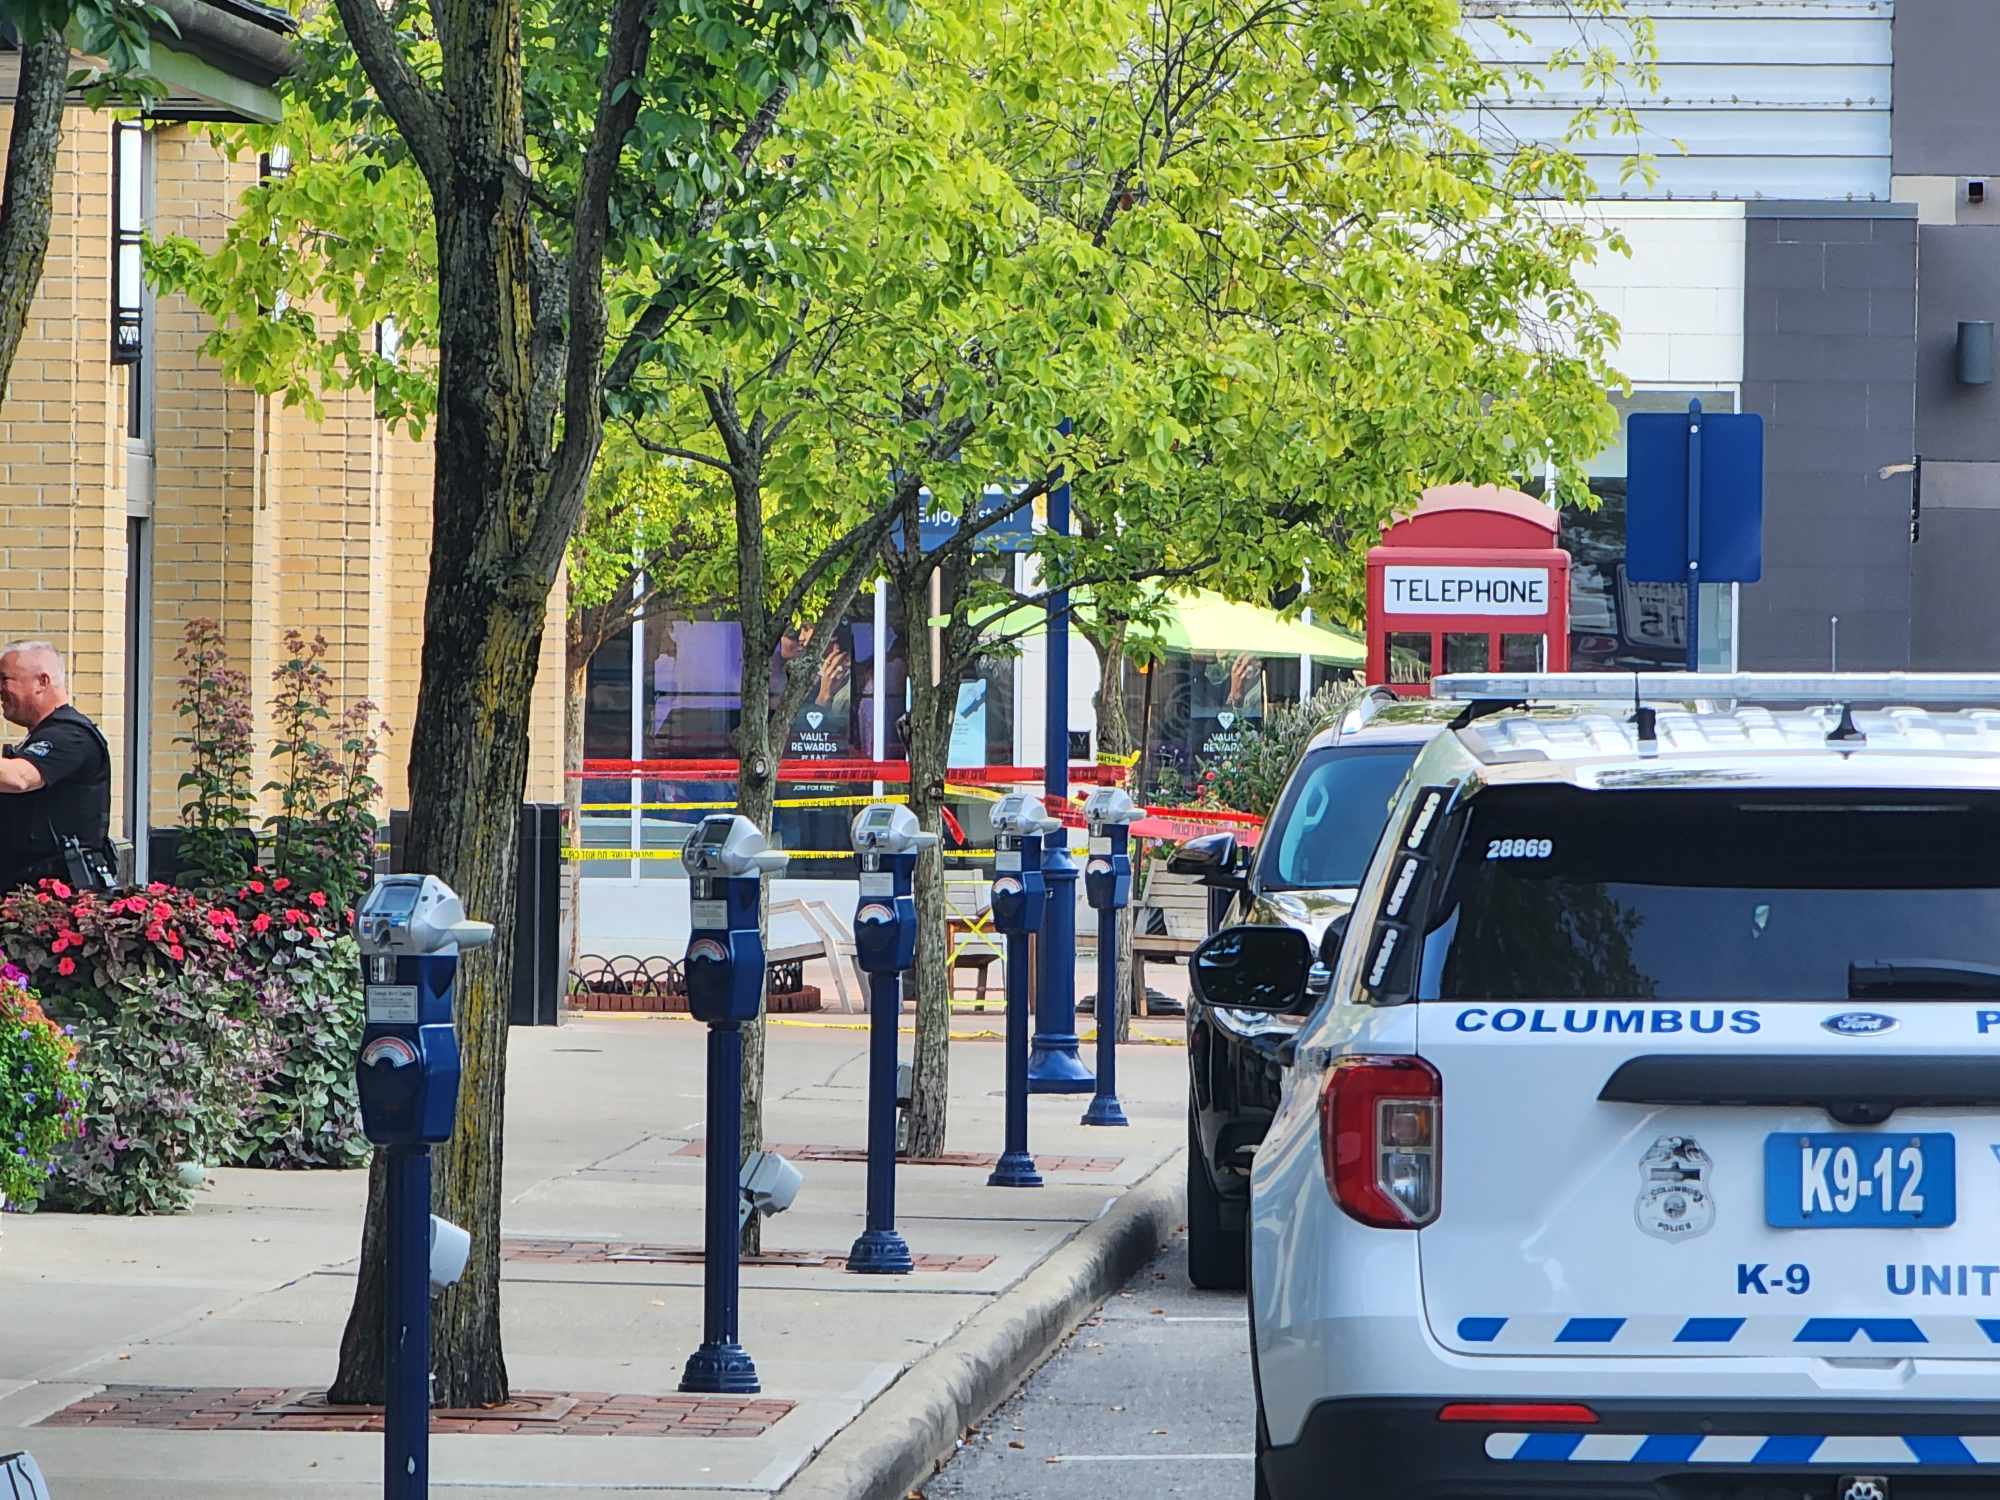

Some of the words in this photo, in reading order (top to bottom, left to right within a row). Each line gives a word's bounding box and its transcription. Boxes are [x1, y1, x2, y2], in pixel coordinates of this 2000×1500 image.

[918, 506, 959, 527] Enjoy
[1390, 579, 1543, 603] TELEPHONE
[791, 742, 837, 752] REWARDS
[800, 732, 829, 741] VAULT
[1486, 838, 1553, 858] 28869
[1455, 1008, 1761, 1034] COLUMBUS
[1837, 1014, 1884, 1032] Ford
[1802, 1146, 1924, 1213] K9-12
[1737, 1263, 1810, 1295] K-9
[1886, 1264, 2000, 1297] UNIT
